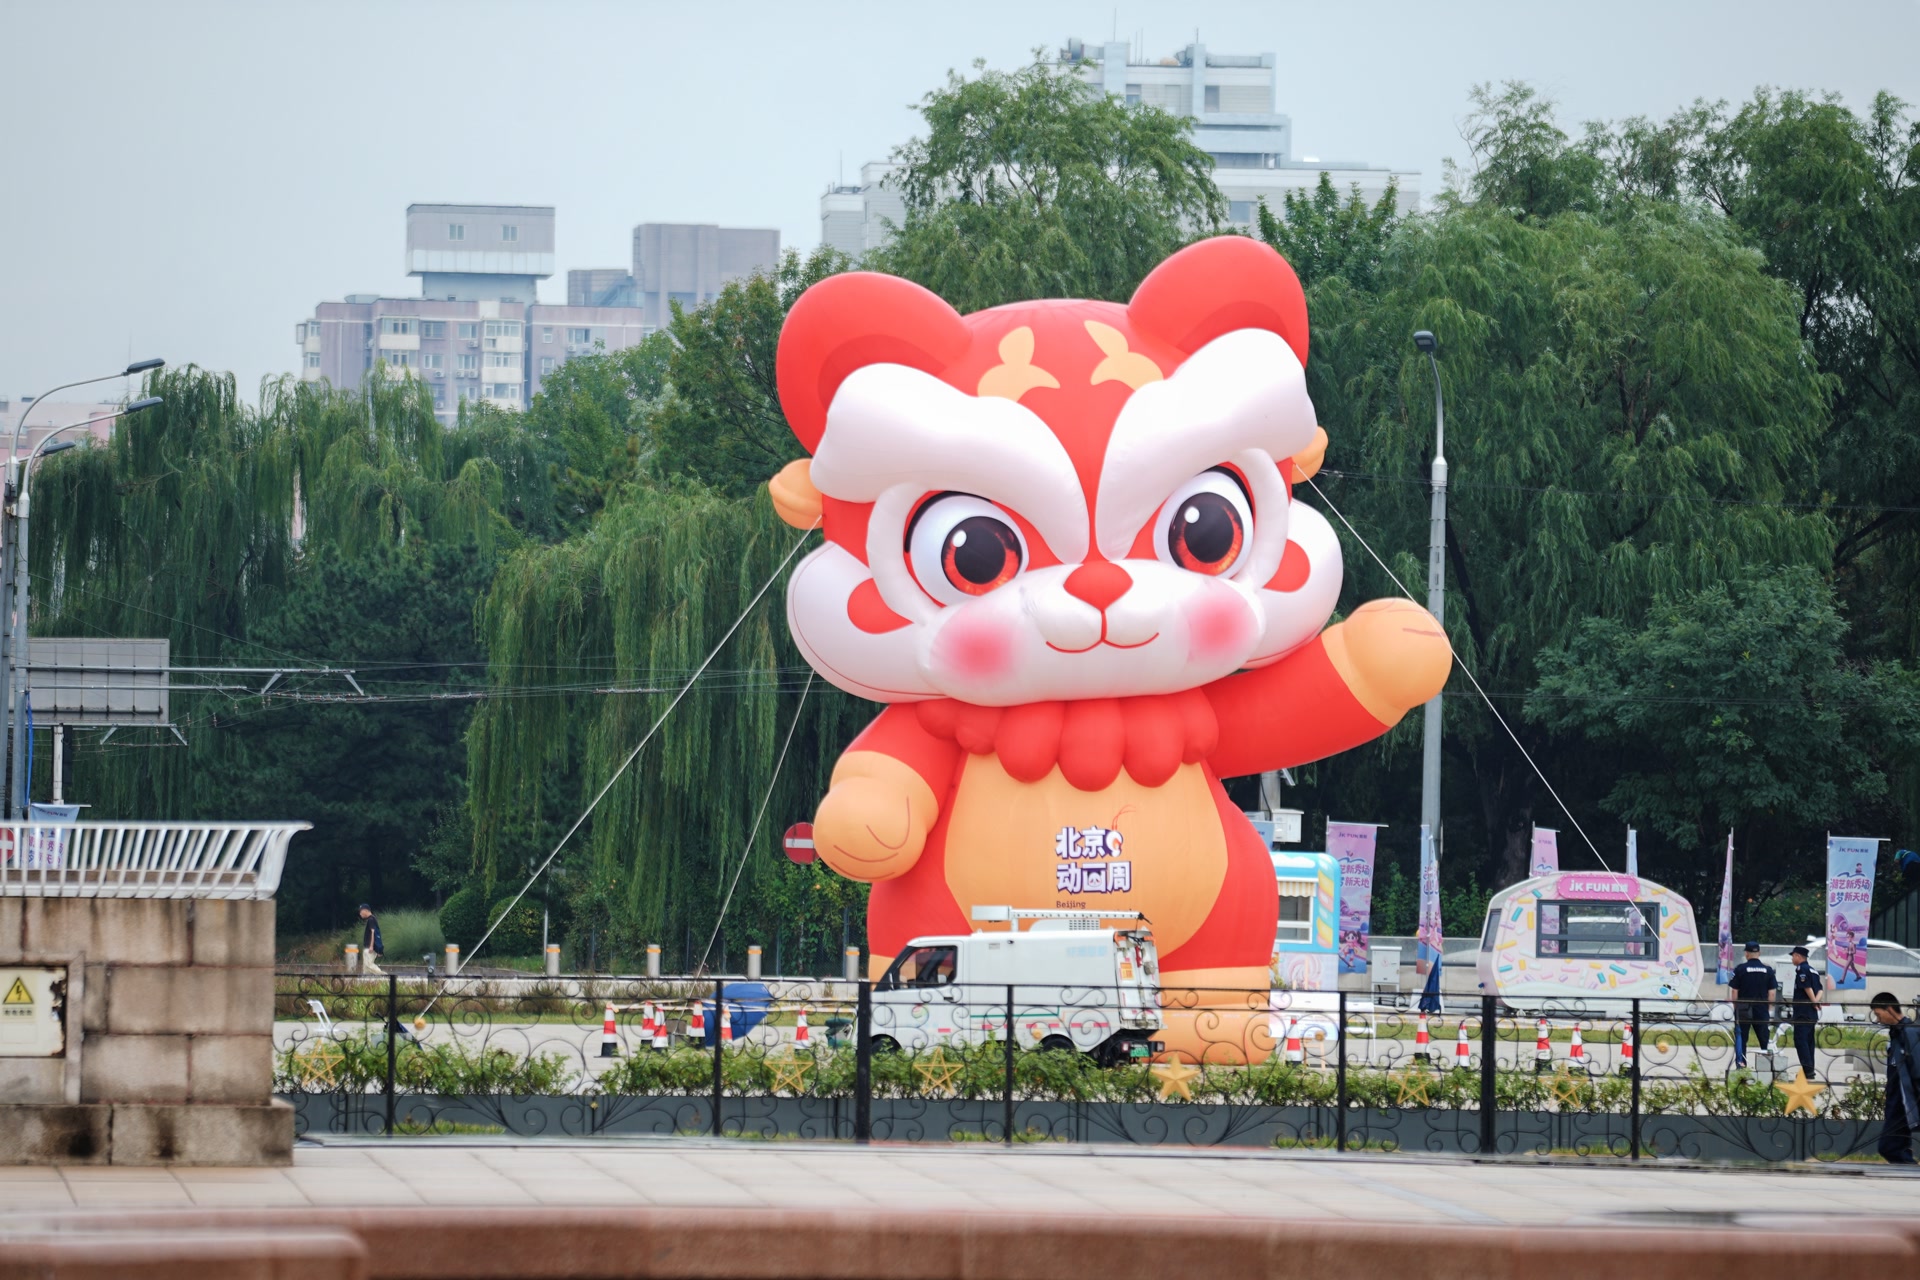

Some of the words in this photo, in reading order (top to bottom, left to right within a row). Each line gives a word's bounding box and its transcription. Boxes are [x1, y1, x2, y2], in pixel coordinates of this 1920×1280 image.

[1056, 860, 1131, 894] 动画周
[1585, 882, 1611, 892] FUN
[1056, 901, 1086, 909] Beijing
